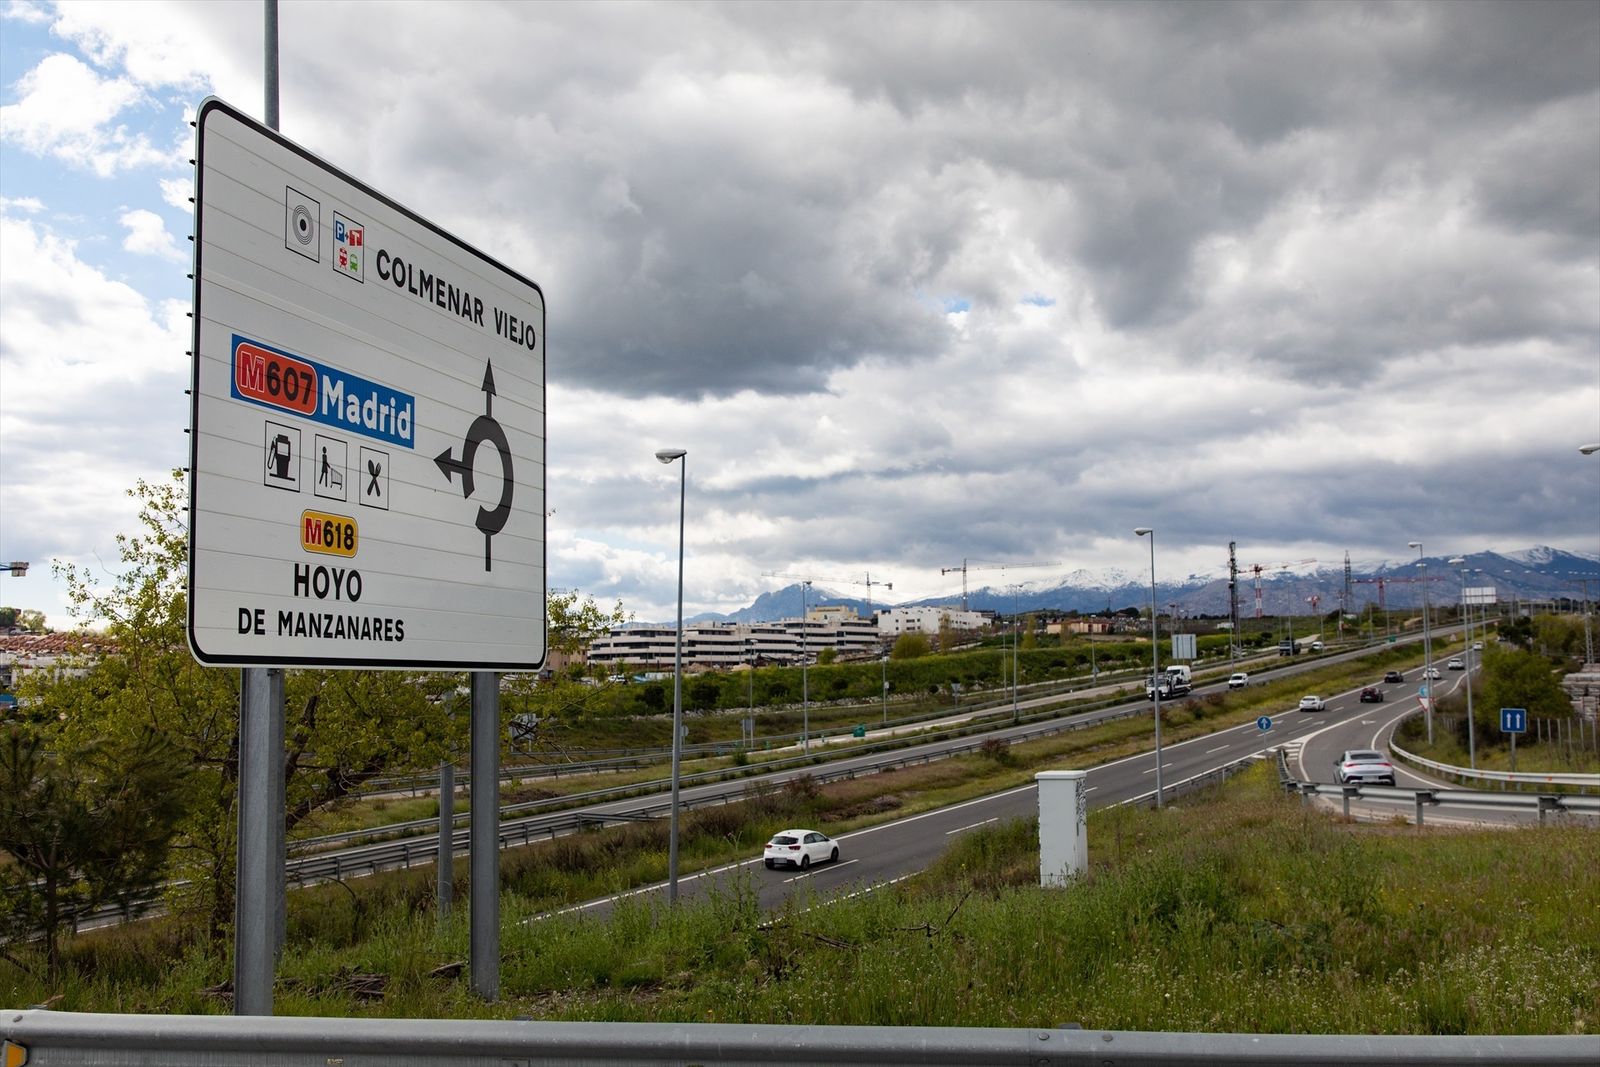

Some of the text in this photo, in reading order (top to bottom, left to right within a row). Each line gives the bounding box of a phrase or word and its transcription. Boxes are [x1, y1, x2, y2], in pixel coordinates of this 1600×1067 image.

[376, 249, 536, 351] COLMENAR VIEJO
[321, 374, 411, 441] Madrid
[304, 517, 355, 552] M618
[294, 563, 362, 602] HOYO
[238, 607, 405, 642] DE MANZANARES
